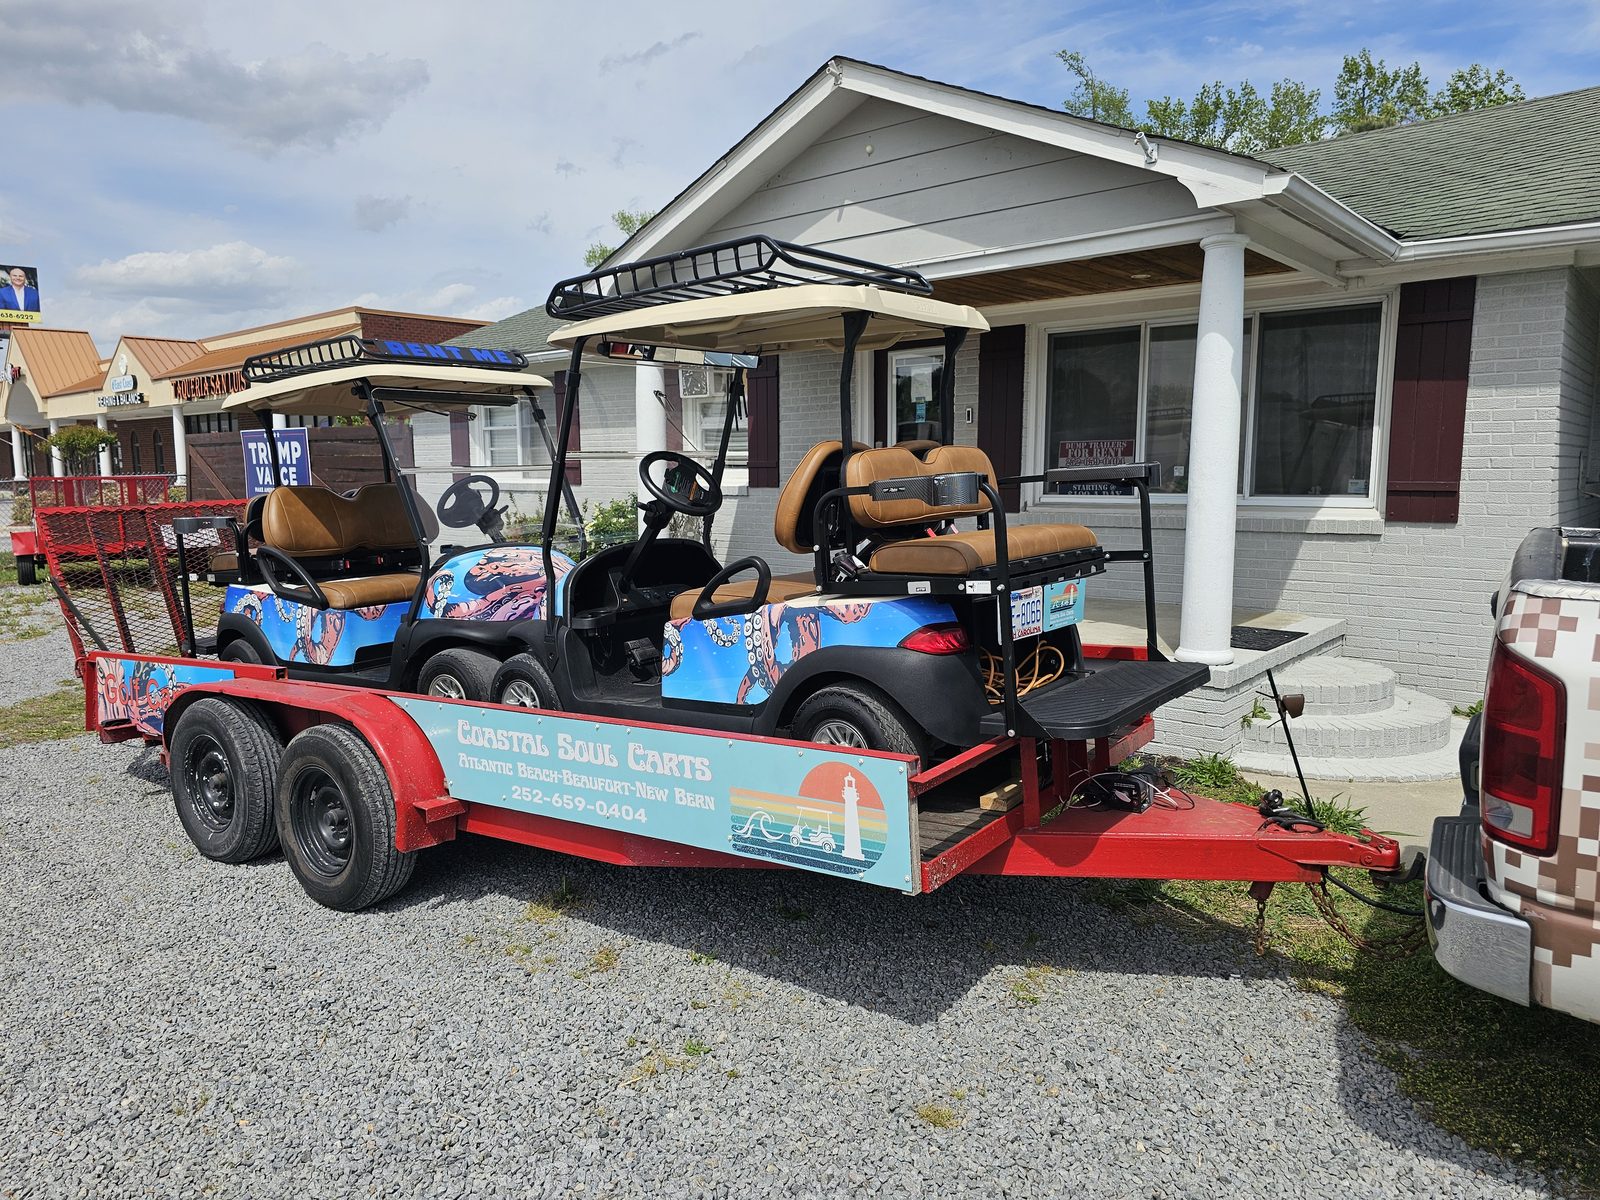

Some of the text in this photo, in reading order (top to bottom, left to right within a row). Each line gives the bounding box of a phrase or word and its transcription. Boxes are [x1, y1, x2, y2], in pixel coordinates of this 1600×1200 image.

[383, 341, 513, 364] RENT ME
[170, 370, 247, 400] TAQUERIA SAN LUIS
[1065, 441, 1127, 450] DUMP TRAILERS
[1067, 447, 1124, 458] FOR RENT
[256, 466, 298, 486] VACE
[104, 673, 140, 707] Golf
[457, 719, 712, 781] COASTAL SOUL CARTS
[458, 752, 514, 776] ATLANTIC
[673, 787, 715, 812] BERN
[511, 785, 648, 824] 252-659-0404
